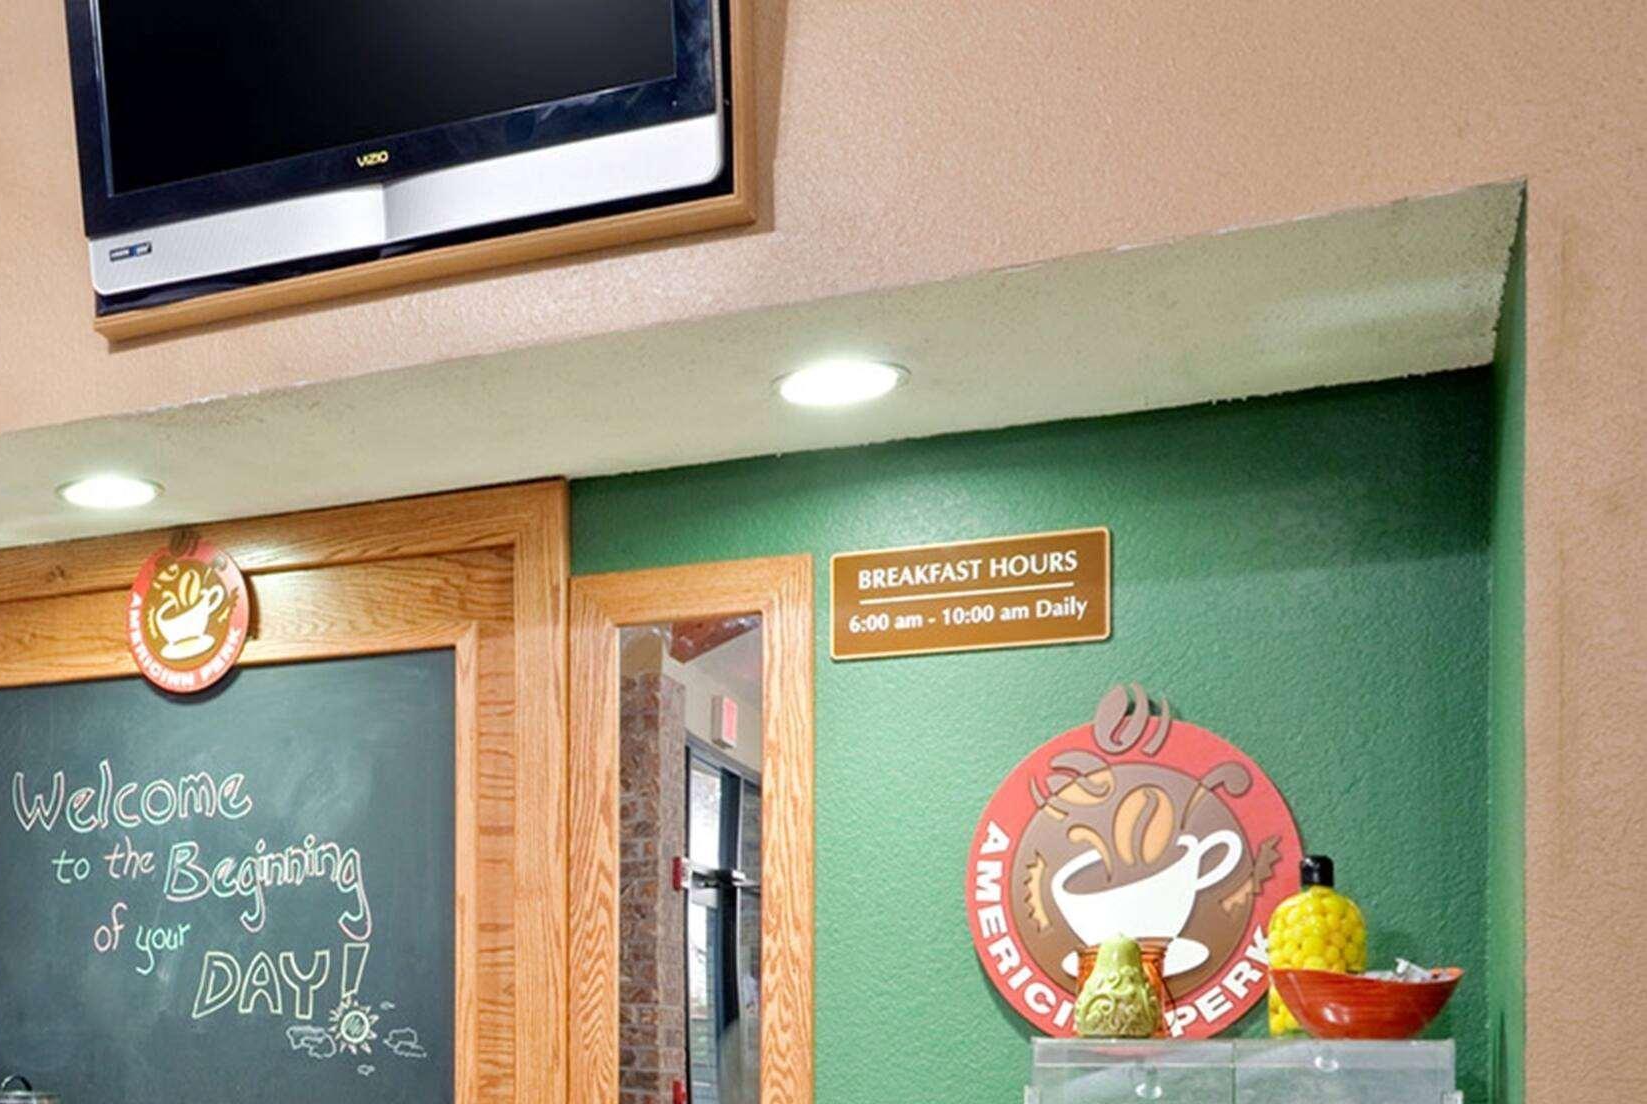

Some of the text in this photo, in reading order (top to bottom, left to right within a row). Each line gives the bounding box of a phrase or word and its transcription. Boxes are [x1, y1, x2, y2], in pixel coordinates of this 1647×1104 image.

[356, 150, 389, 168] VIZIO
[858, 550, 1079, 590] BREAKFAST HOURS
[848, 614, 889, 634] 6:00
[894, 613, 923, 631] am
[942, 605, 995, 625] 10:00
[999, 604, 1030, 621] am
[1035, 597, 1088, 619] Daily
[11, 760, 253, 833] Welcome
[51, 834, 373, 941] to the Beginning
[92, 903, 191, 975] of your
[191, 942, 371, 1019] DAY!
[1164, 925, 1270, 1038] PERK
